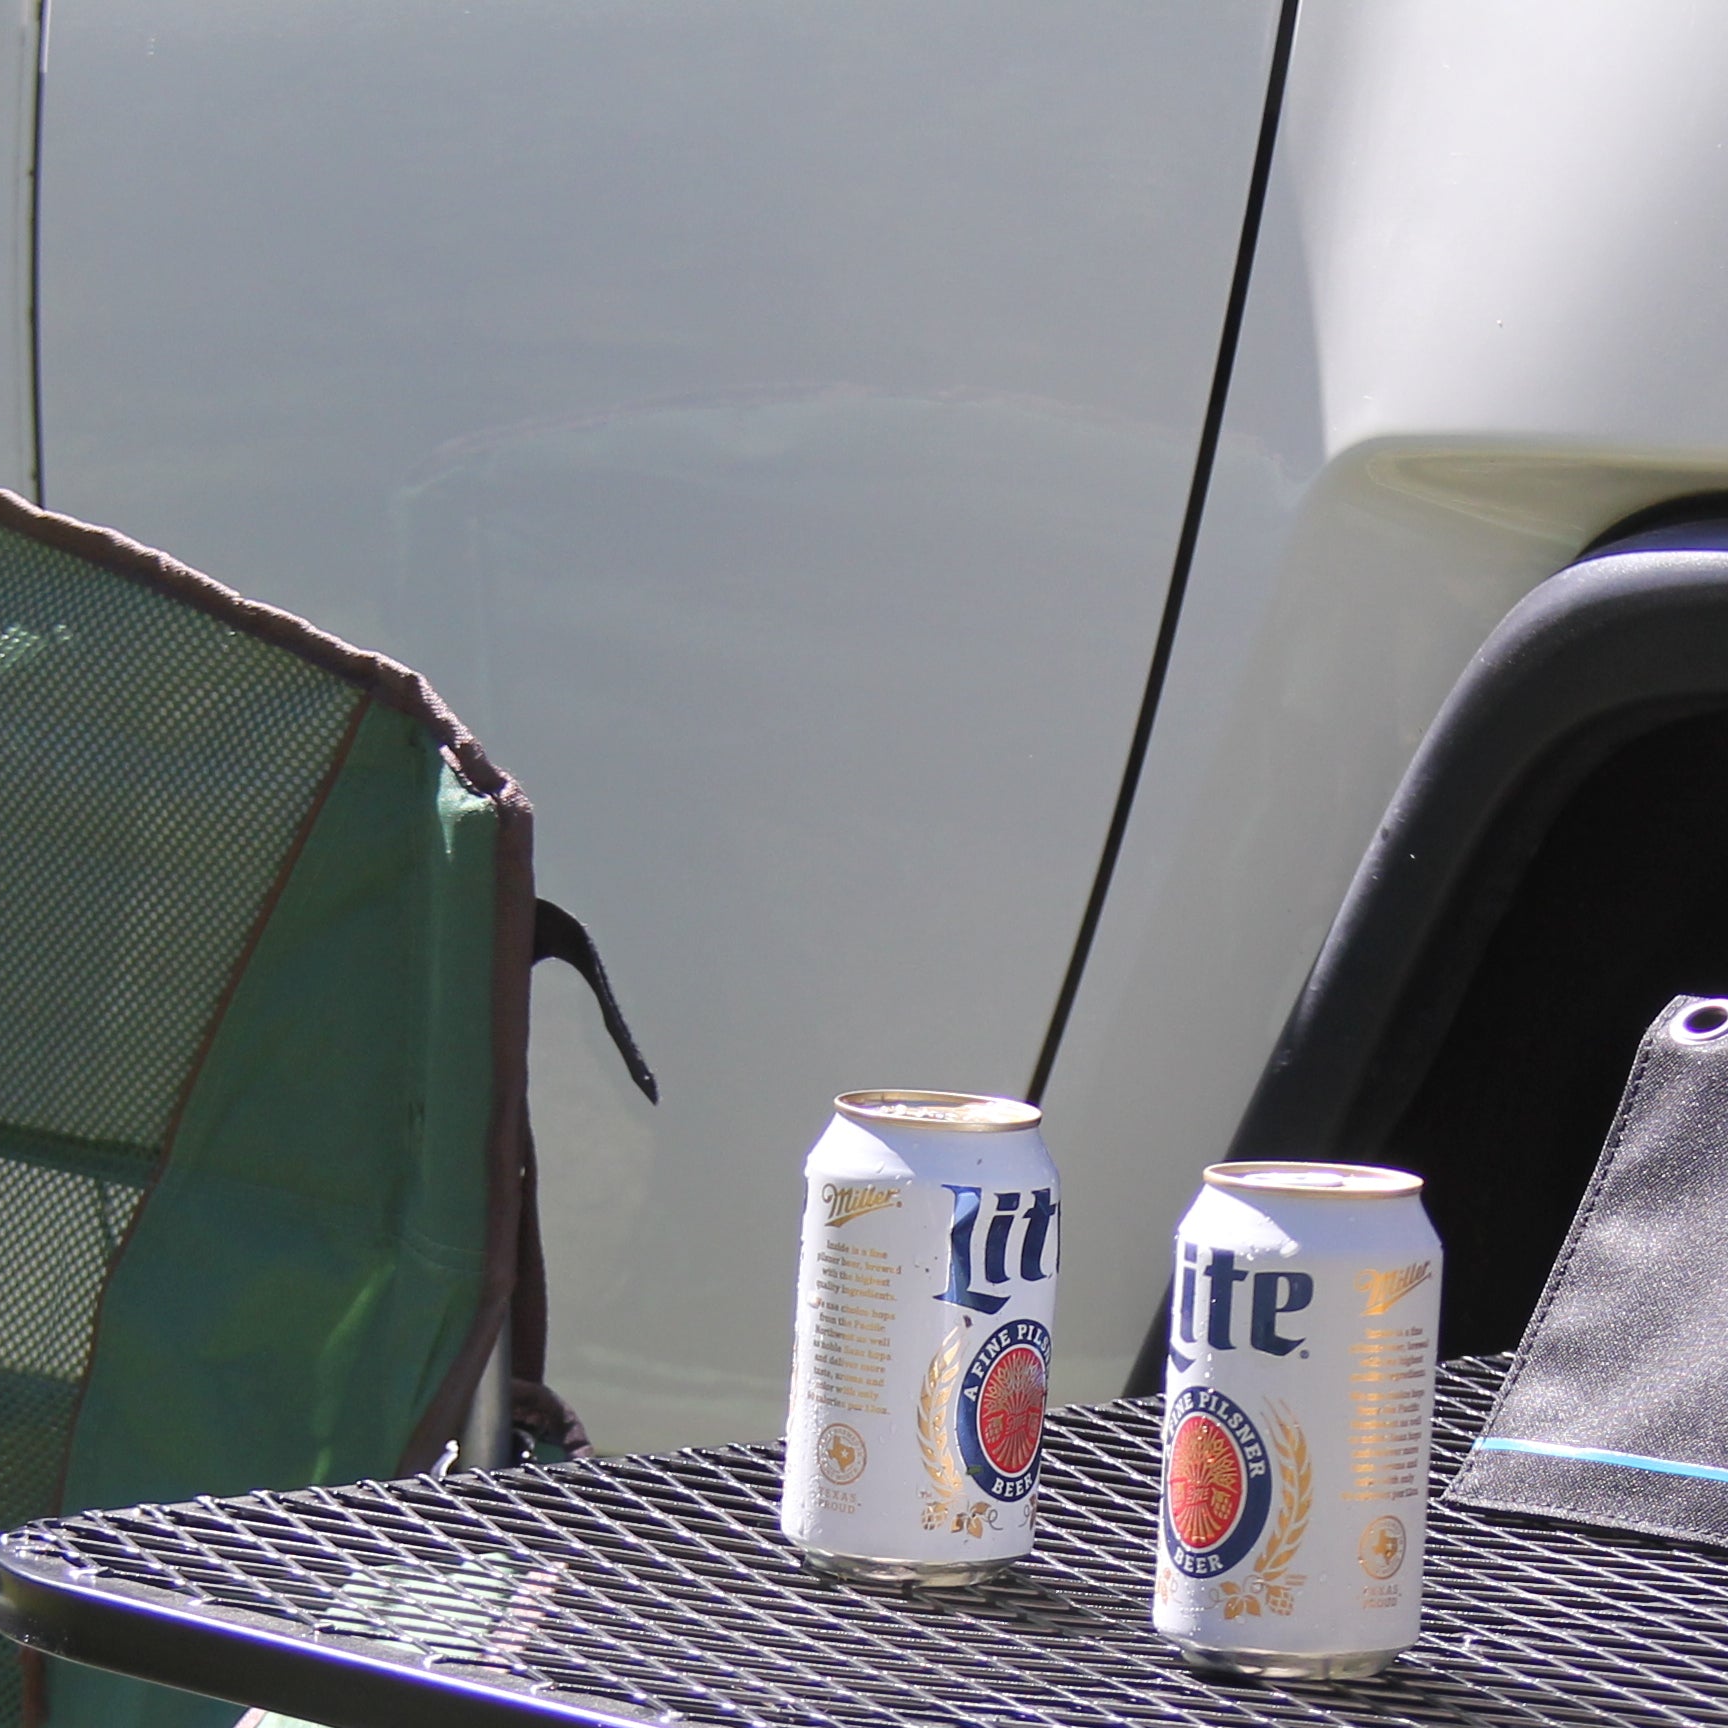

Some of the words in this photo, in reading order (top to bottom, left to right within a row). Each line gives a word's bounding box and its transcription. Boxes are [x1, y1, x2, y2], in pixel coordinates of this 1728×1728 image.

[822, 1183, 902, 1224] Miller
[932, 1183, 1061, 1315] Lit
[1355, 1260, 1431, 1308] Miller
[964, 1385, 979, 1402] A
[972, 1329, 1011, 1379] FINE
[1199, 1391, 1266, 1478] PILSNER
[992, 1473, 1033, 1498] BEER
[1174, 1546, 1223, 1575] BEER
